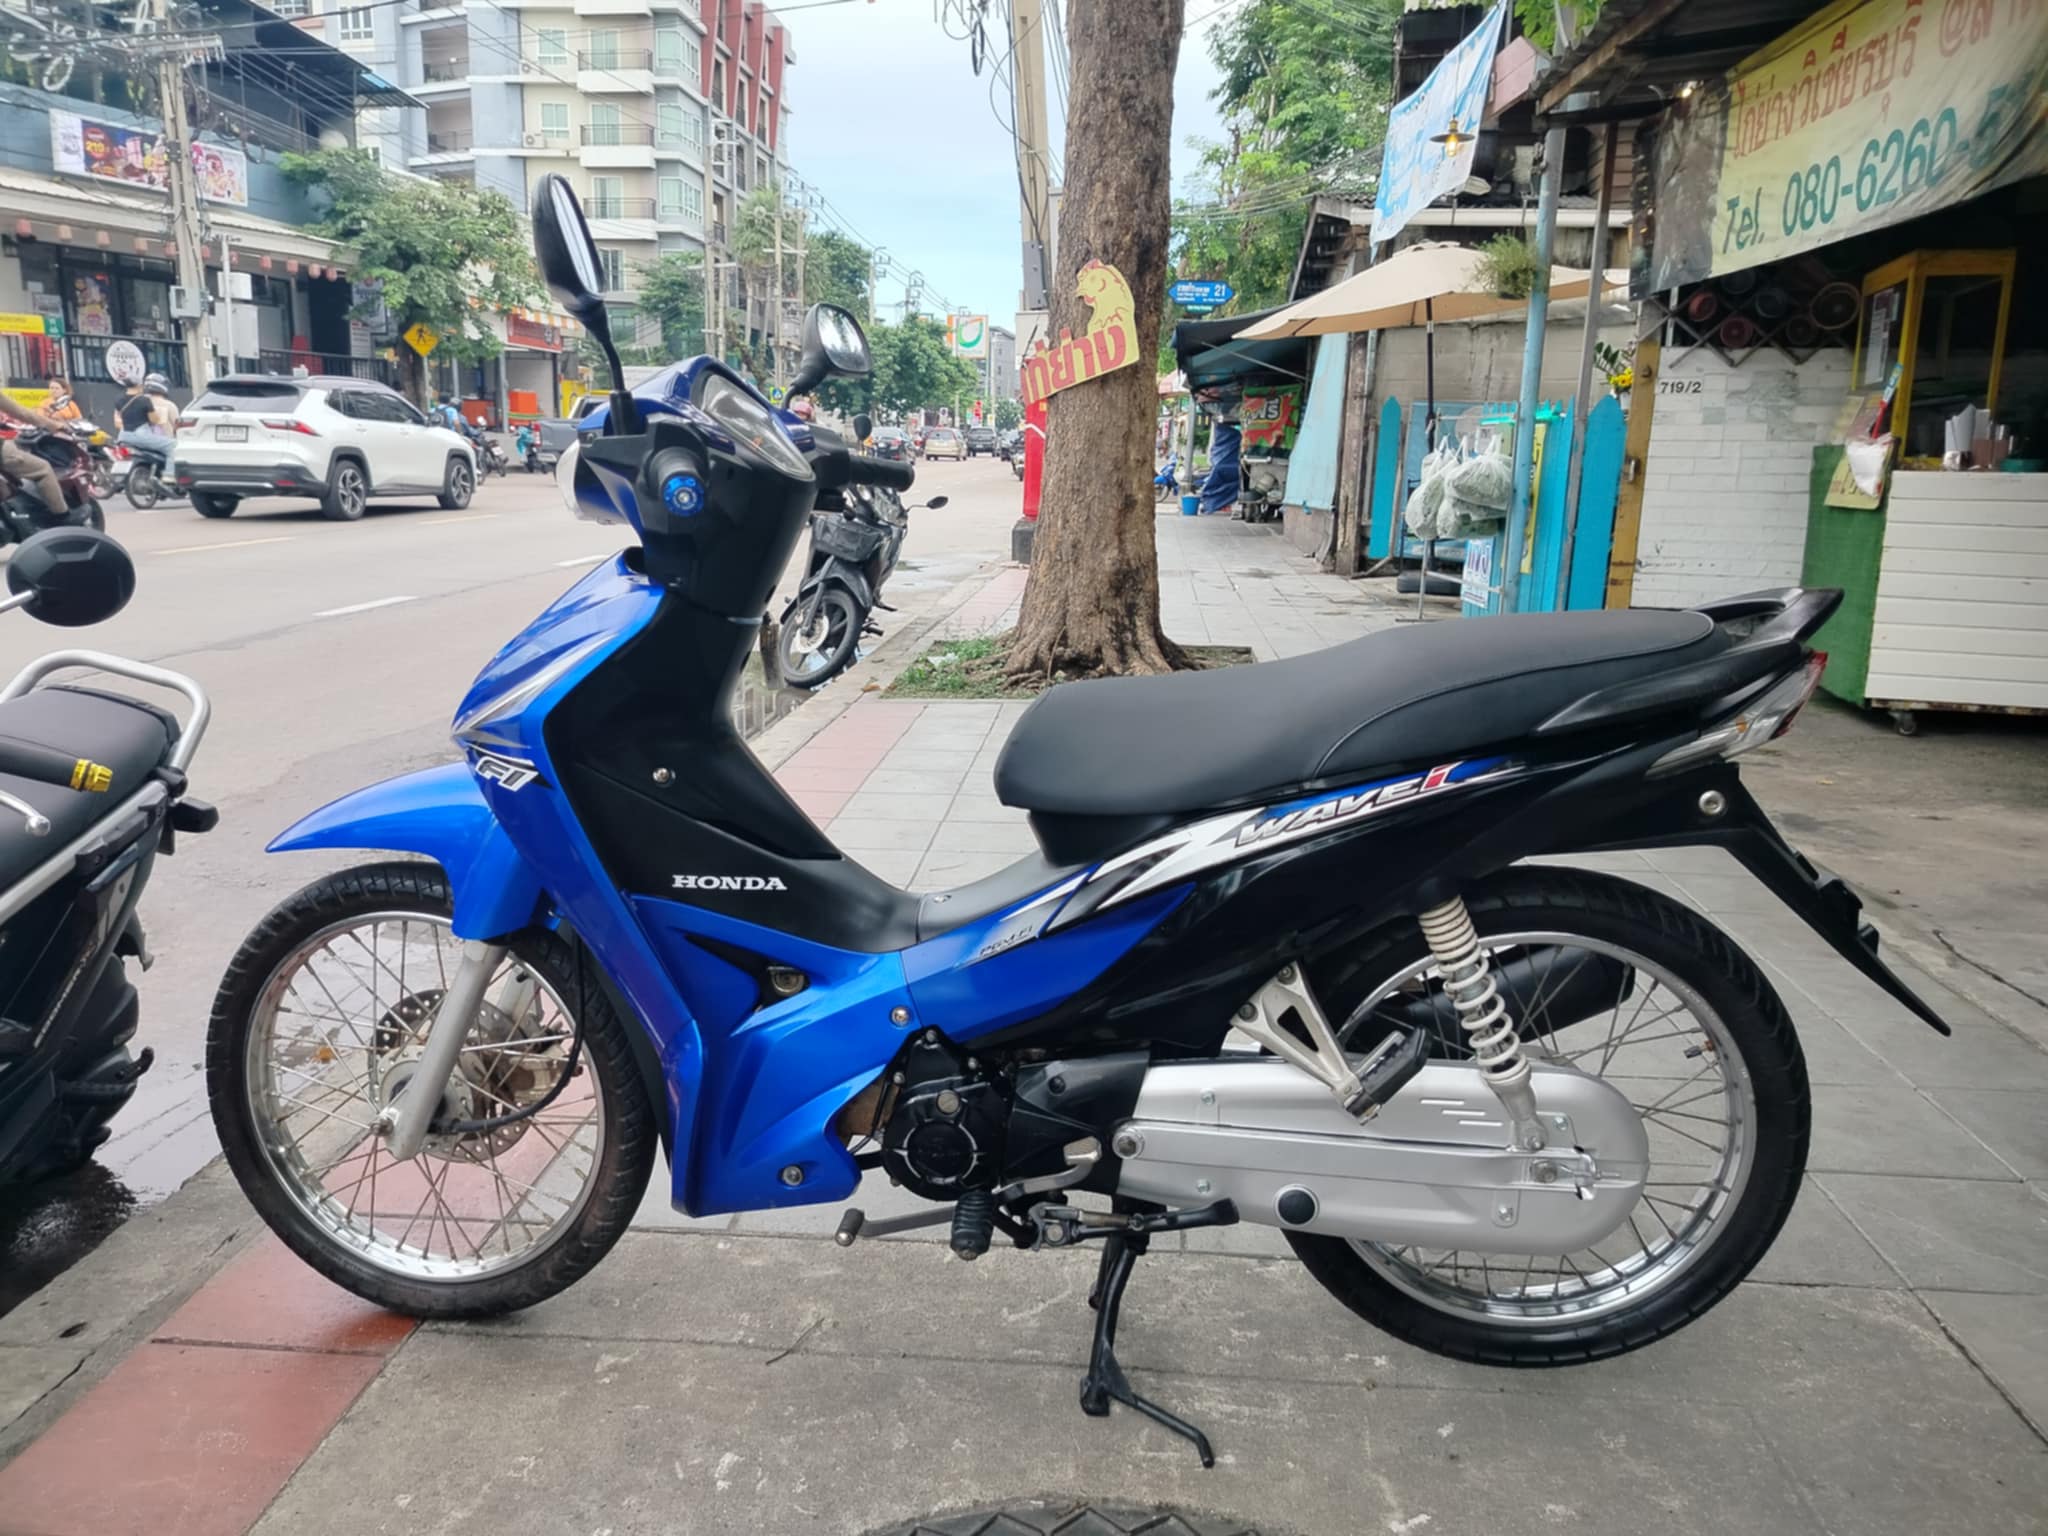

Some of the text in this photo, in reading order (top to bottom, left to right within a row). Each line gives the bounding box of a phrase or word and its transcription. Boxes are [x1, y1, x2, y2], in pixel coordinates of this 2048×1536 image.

[1722, 186, 1765, 254] Tel.
[1214, 283, 1226, 297] 21
[1660, 381, 1702, 394] 719/2
[671, 874, 788, 891] HONDA
